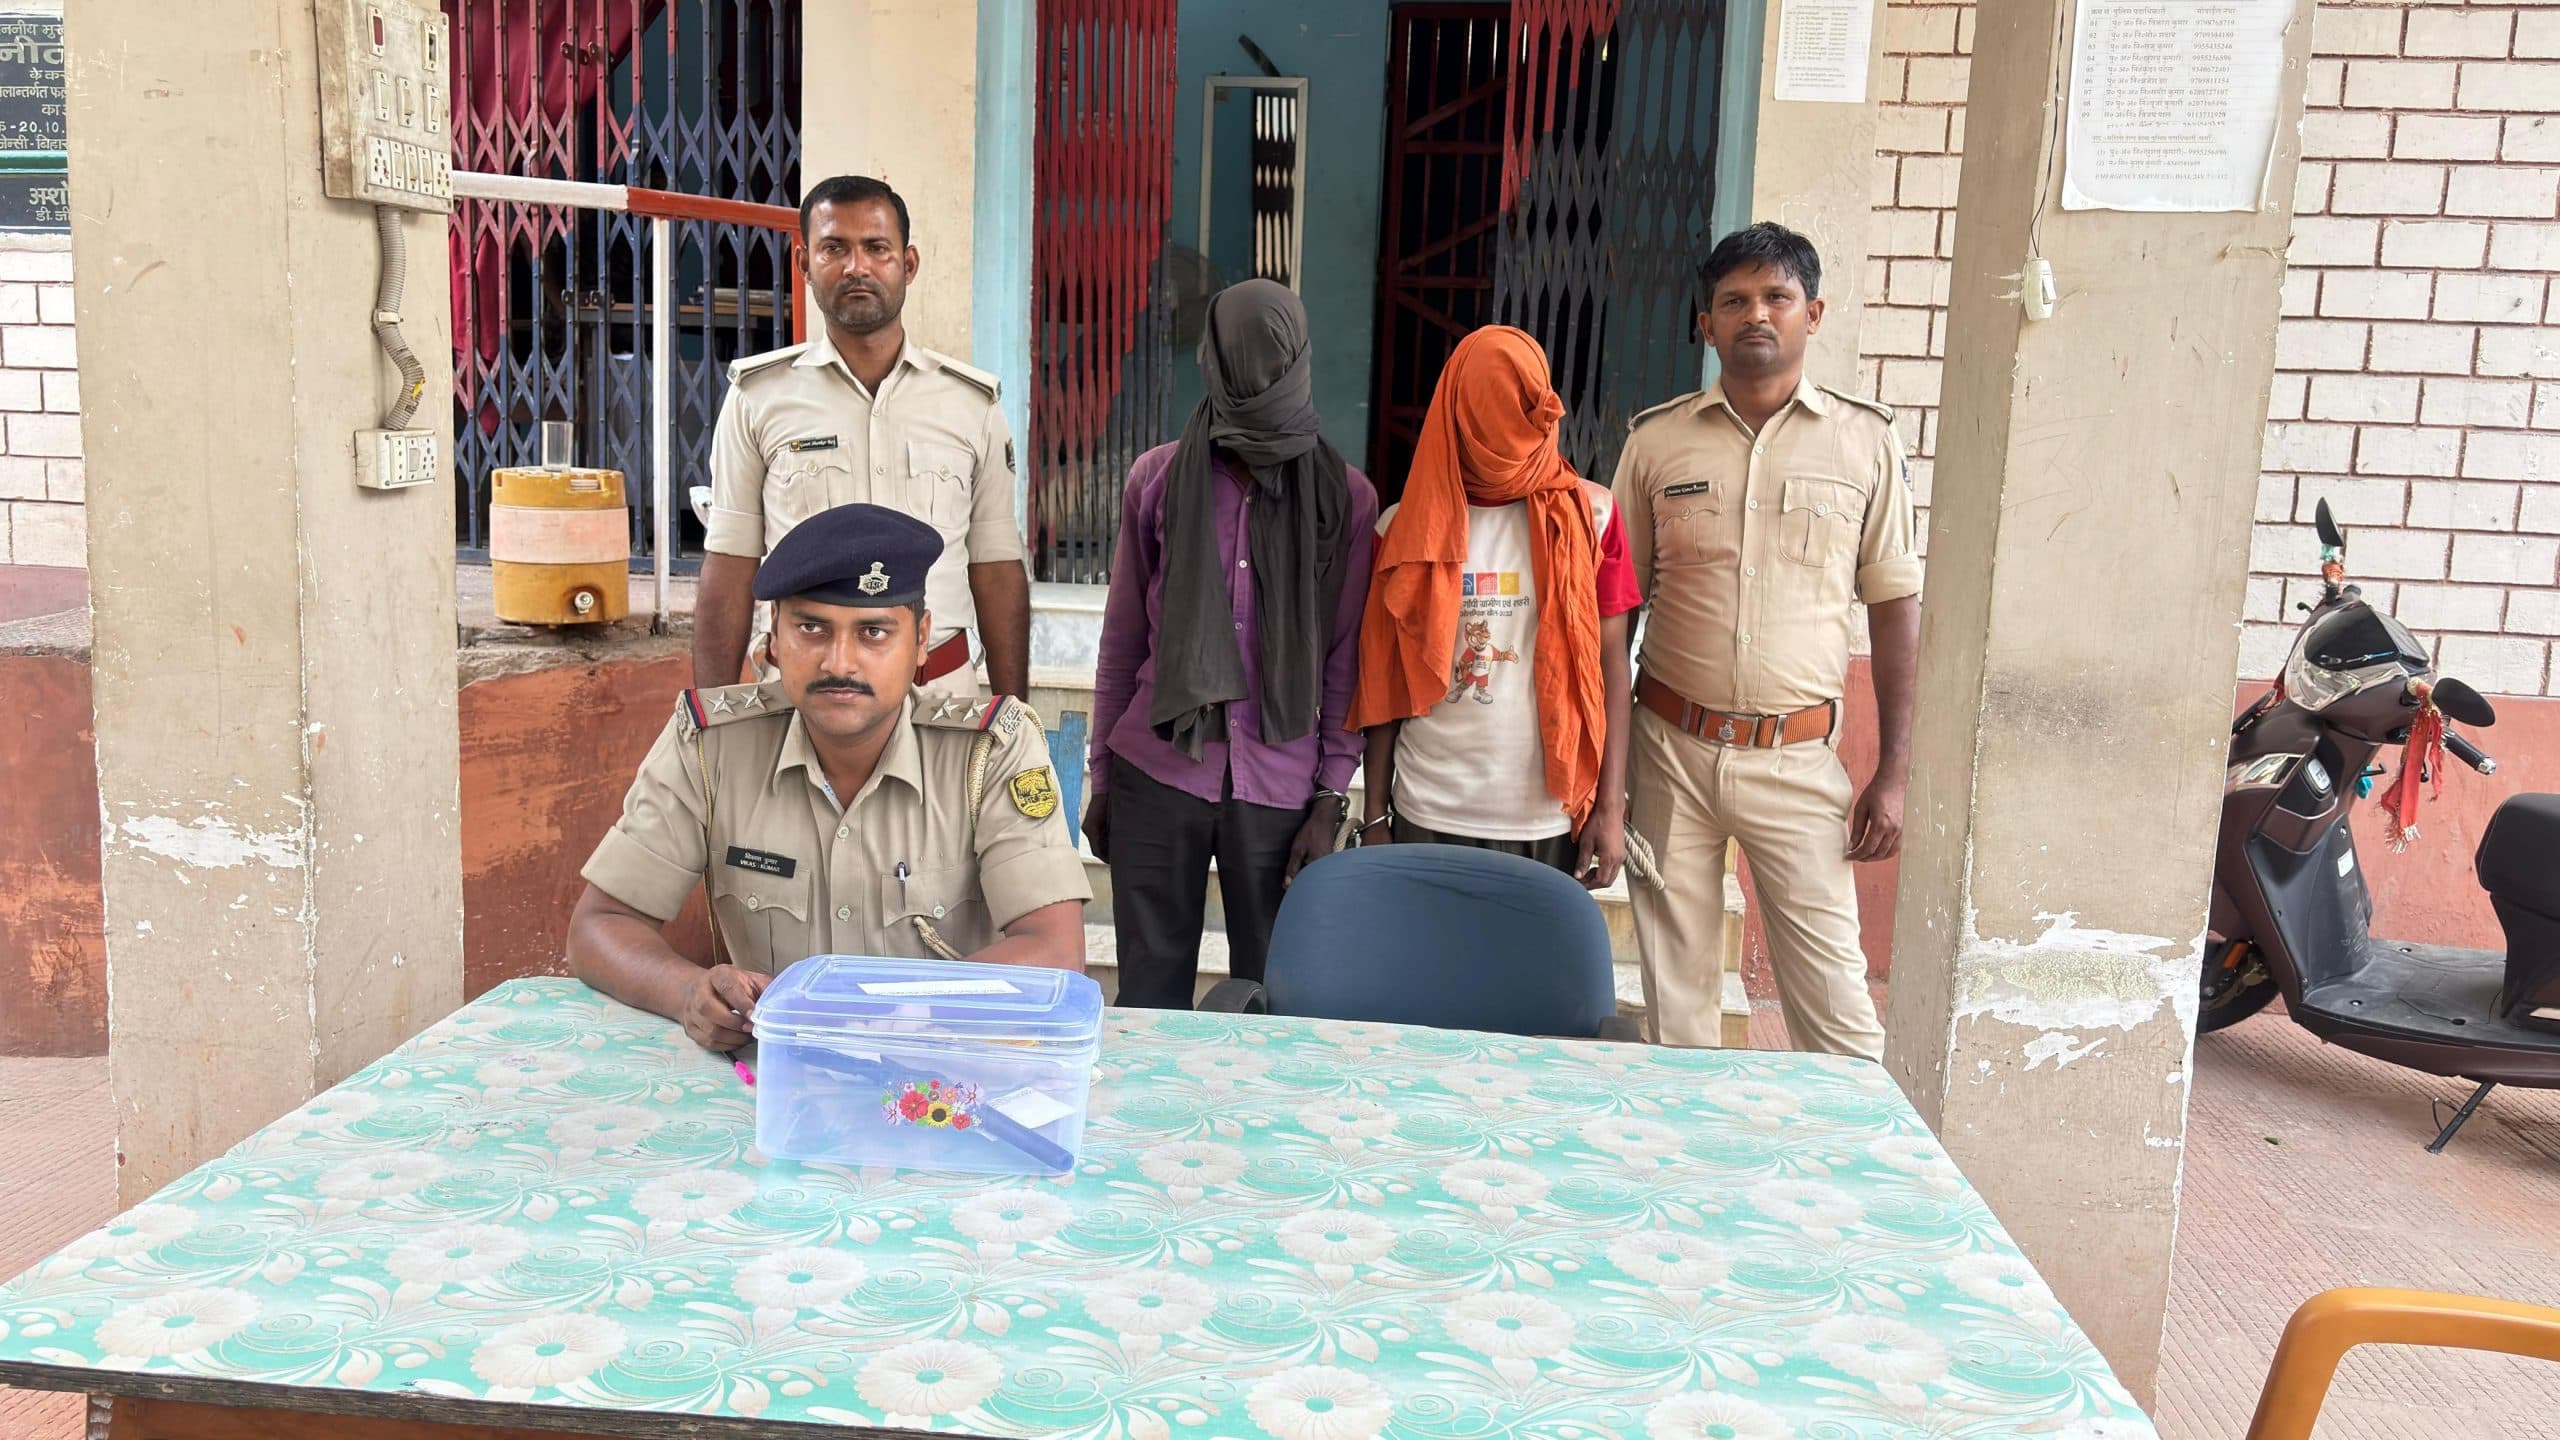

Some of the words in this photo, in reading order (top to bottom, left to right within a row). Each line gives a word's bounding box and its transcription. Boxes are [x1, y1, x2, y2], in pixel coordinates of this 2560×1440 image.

[29, 66, 43, 81] के
[44, 71, 65, 81] क
[0, 81, 48, 99] लान्तर्गत
[41, 104, 61, 116] का
